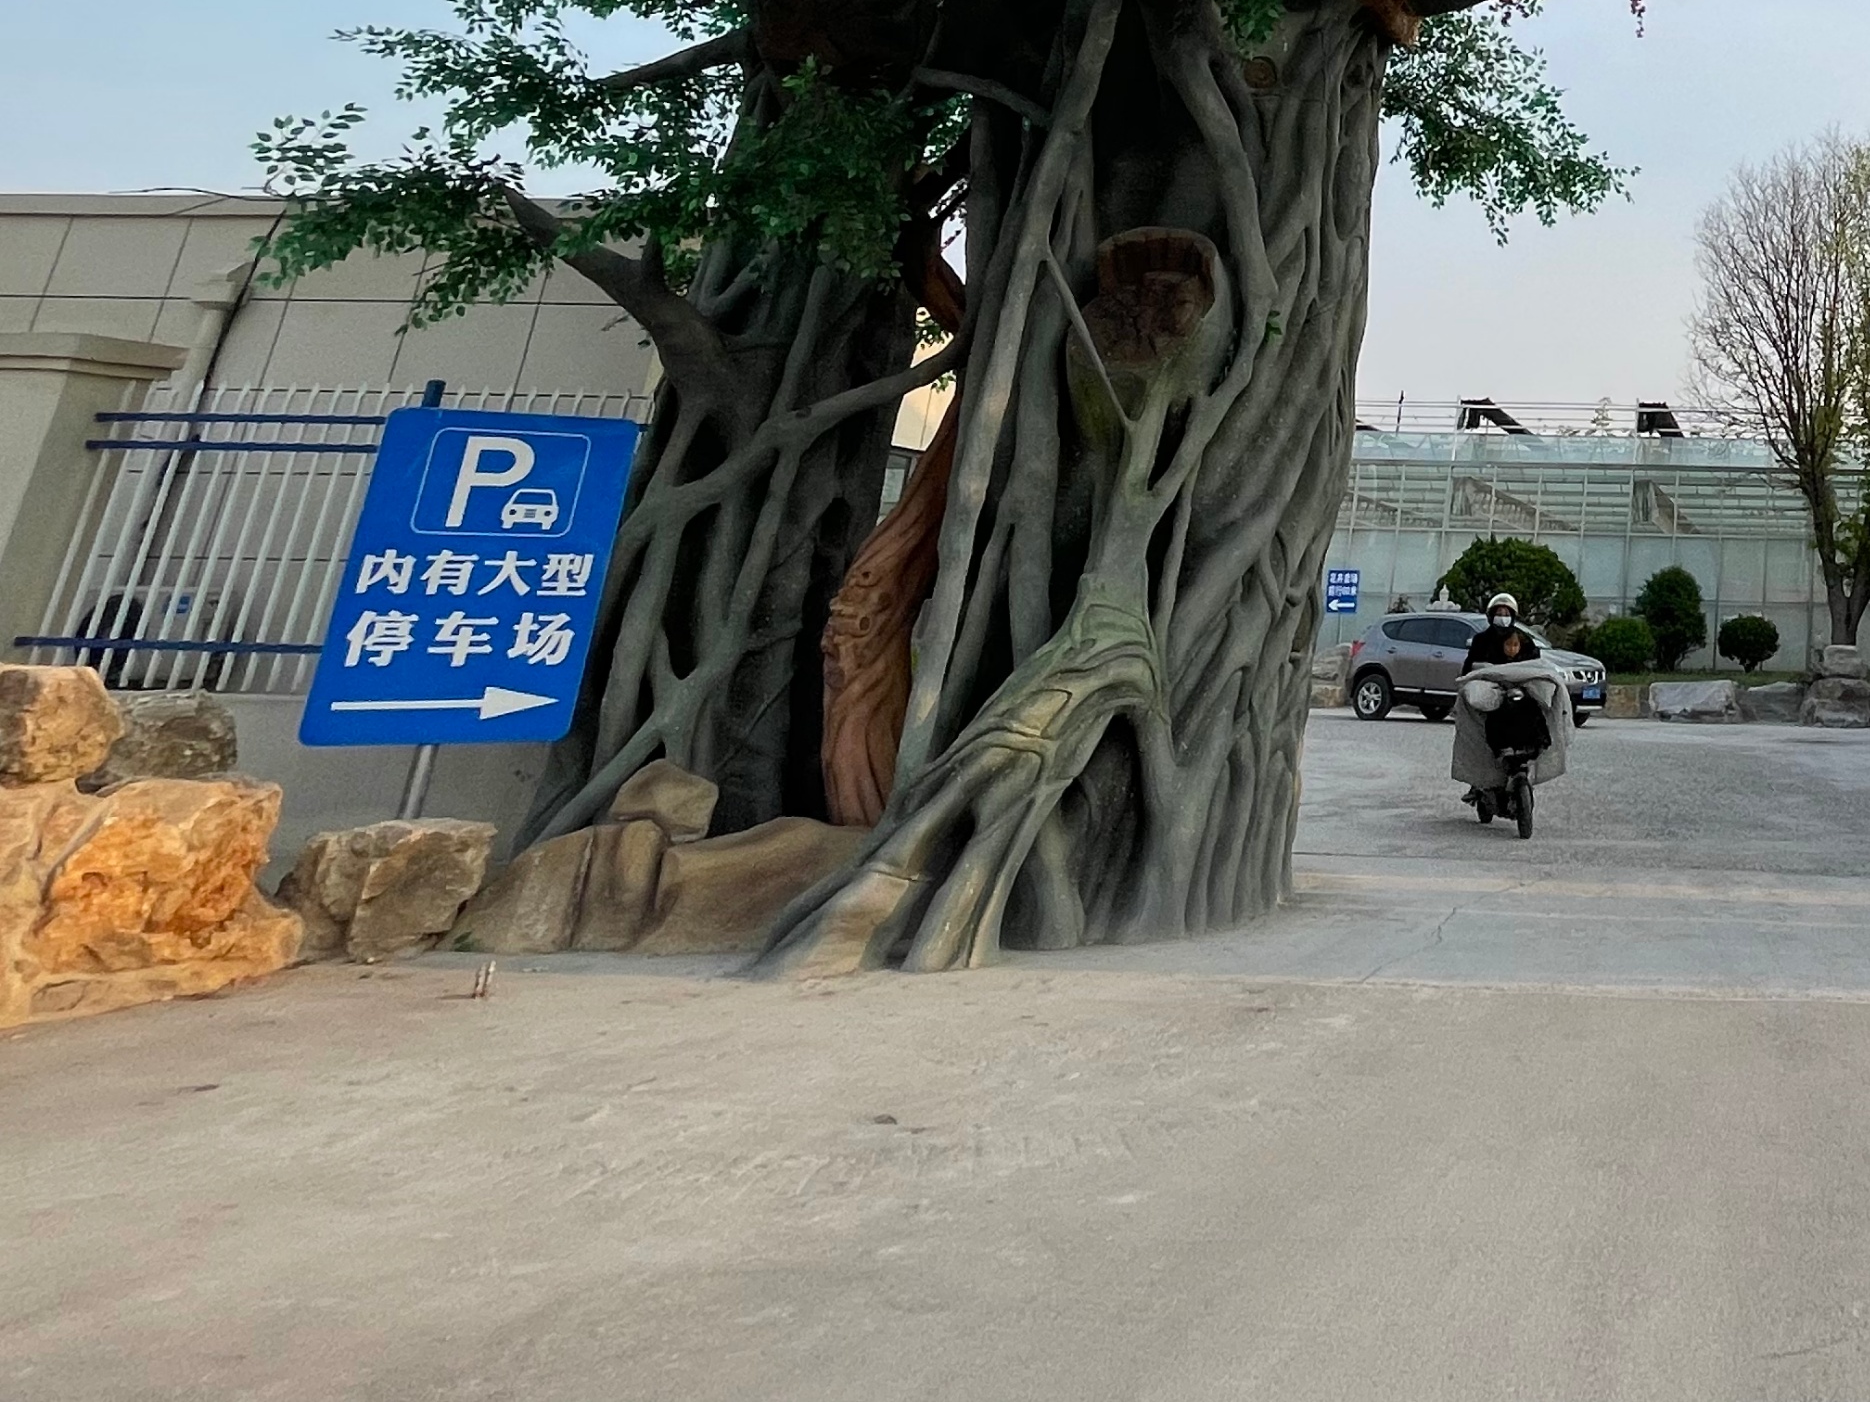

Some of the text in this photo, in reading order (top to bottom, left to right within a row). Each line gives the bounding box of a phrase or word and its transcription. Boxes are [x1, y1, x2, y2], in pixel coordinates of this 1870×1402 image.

[445, 435, 536, 528] P
[355, 548, 594, 597] 内有大型
[344, 610, 576, 668] 停车场
